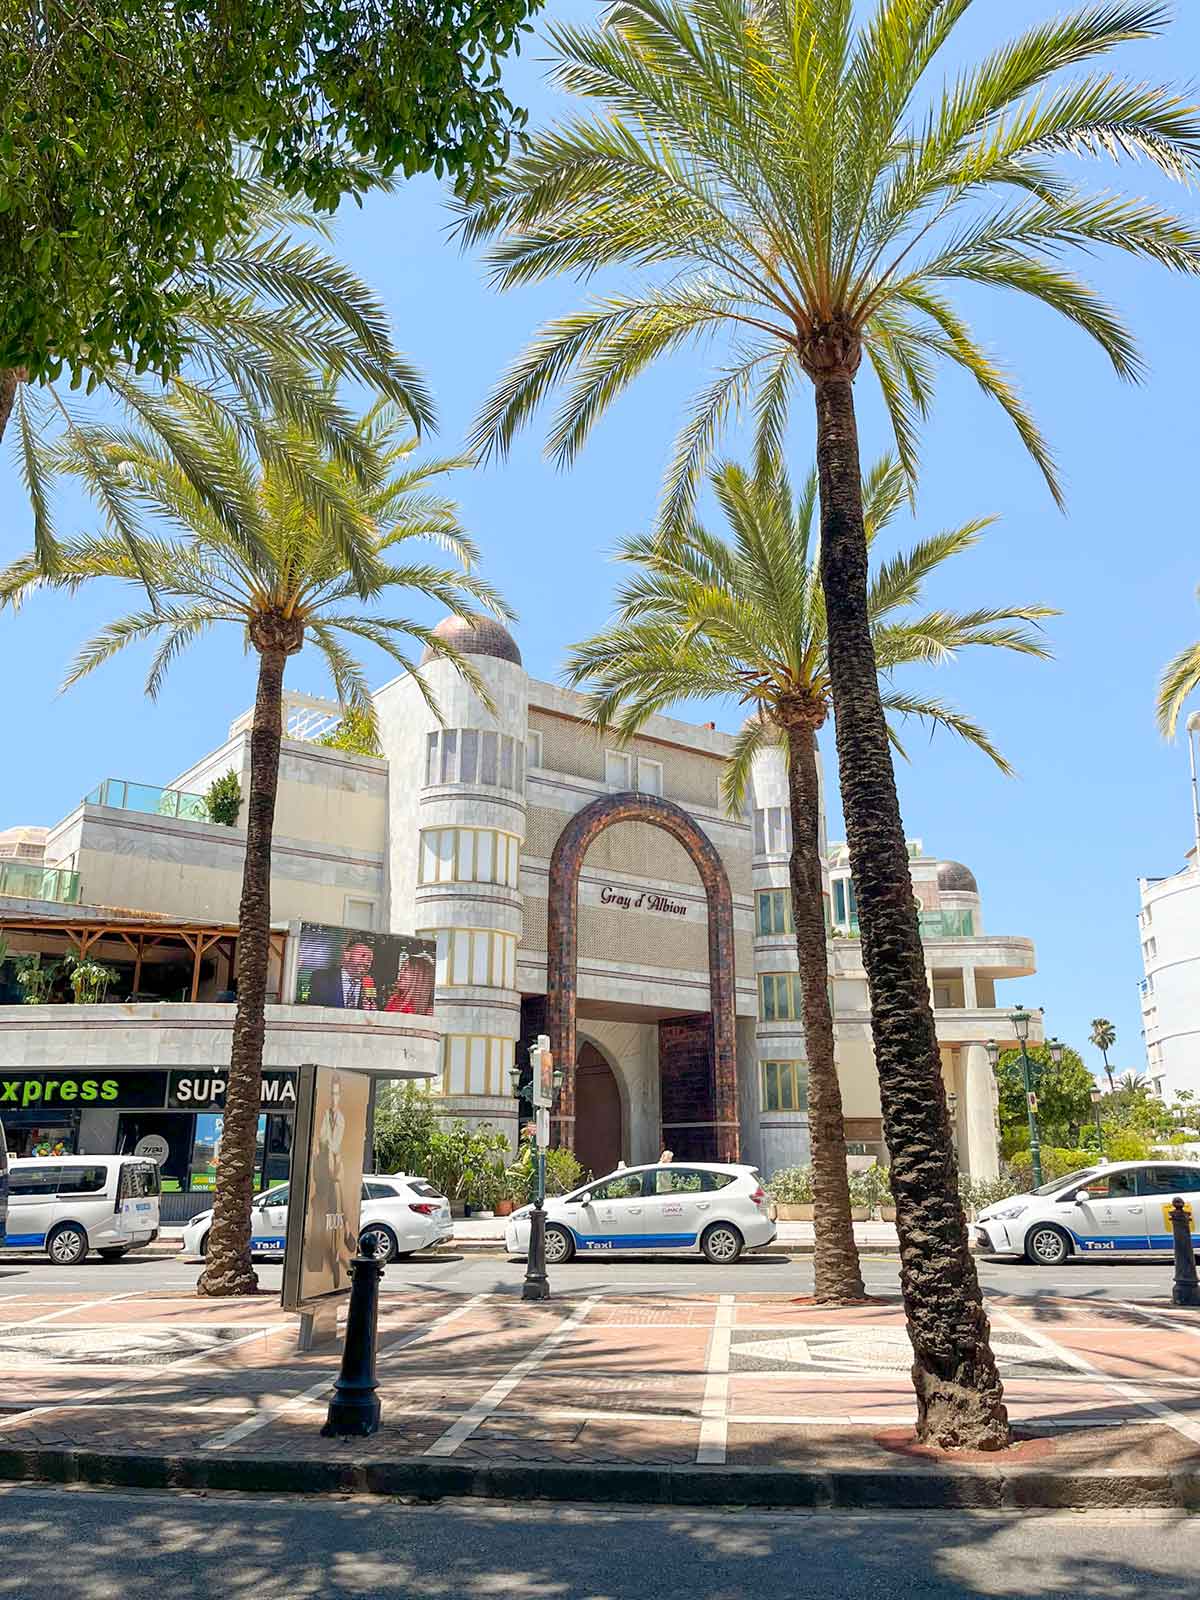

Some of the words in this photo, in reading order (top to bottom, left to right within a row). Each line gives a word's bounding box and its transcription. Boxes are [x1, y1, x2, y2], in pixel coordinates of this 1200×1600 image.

[600, 886, 631, 909] Gray
[176, 1079, 296, 1101] SUPMA
[255, 1241, 280, 1249] Taxi
[586, 1241, 613, 1249] Taxi
[1085, 1241, 1114, 1249] Taxi
